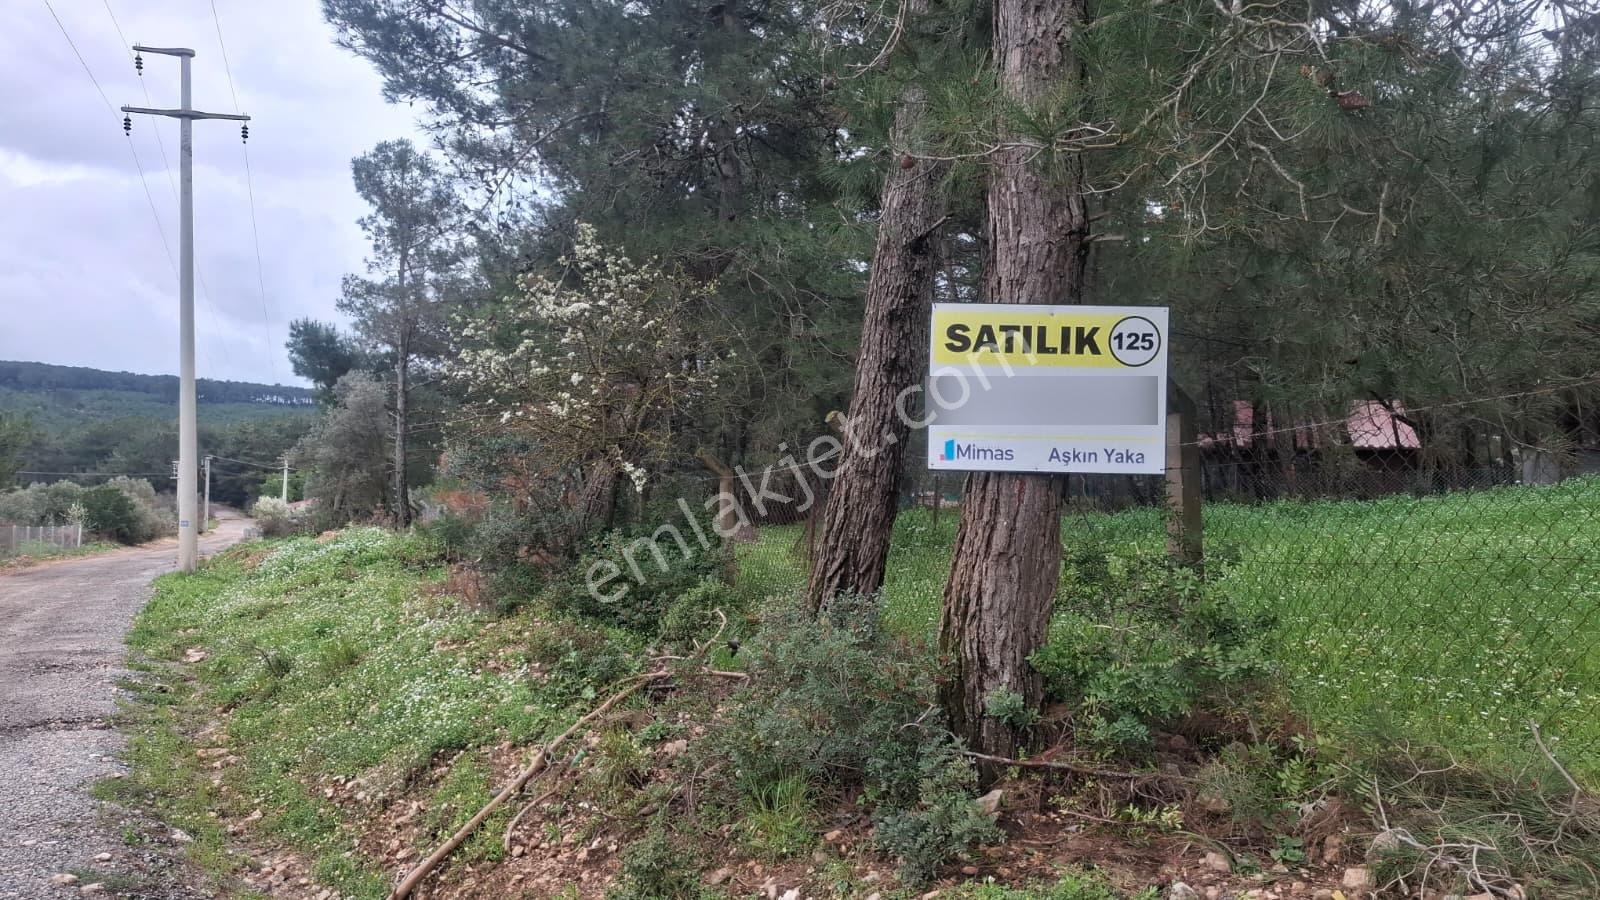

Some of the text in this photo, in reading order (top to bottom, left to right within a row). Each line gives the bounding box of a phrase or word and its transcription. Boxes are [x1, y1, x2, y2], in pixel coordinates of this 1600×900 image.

[944, 323, 1154, 356] SATILIK 125
[956, 444, 1014, 461] Mimas
[1048, 447, 1145, 467] Aşkın Yaka
